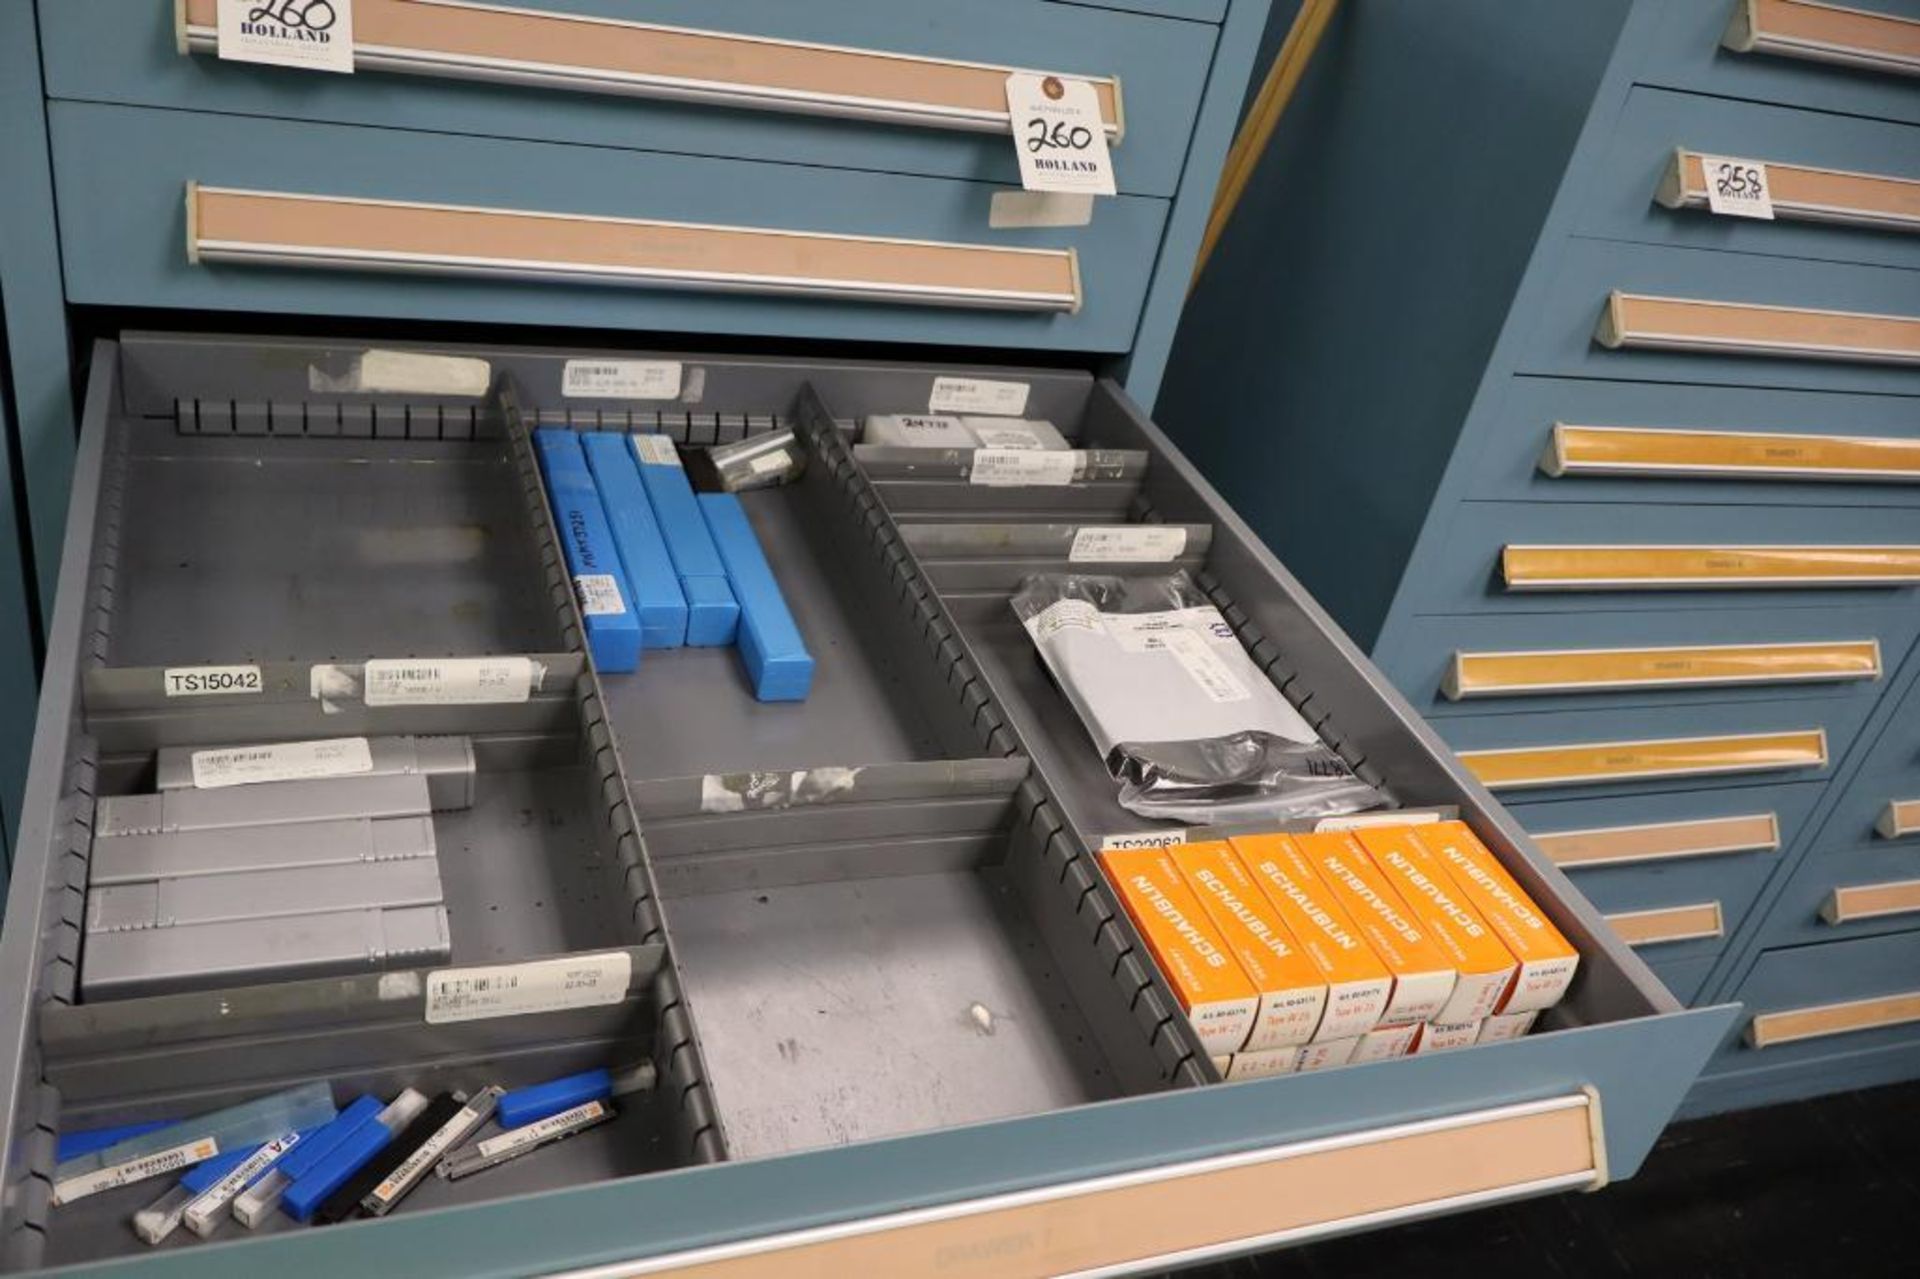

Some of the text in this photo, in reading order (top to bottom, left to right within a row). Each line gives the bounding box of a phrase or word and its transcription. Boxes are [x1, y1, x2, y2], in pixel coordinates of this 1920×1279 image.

[240, 22, 331, 44] HOLLAND
[249, 0, 337, 31] 260
[1027, 117, 1092, 153] 260
[1034, 158, 1098, 173] HOLLAND
[1717, 163, 1762, 194] 258
[169, 671, 259, 692] TS15042
[1195, 868, 1292, 958] SCHAUBLIN
[1260, 860, 1357, 951] SCHAUBLIN
[1323, 856, 1422, 944] SCHAUBLIN
[1386, 851, 1485, 939] SCHAUBLIN
[1444, 846, 1543, 930] SCHAUBLIN
[1131, 875, 1226, 969] SCHAUBLIN
